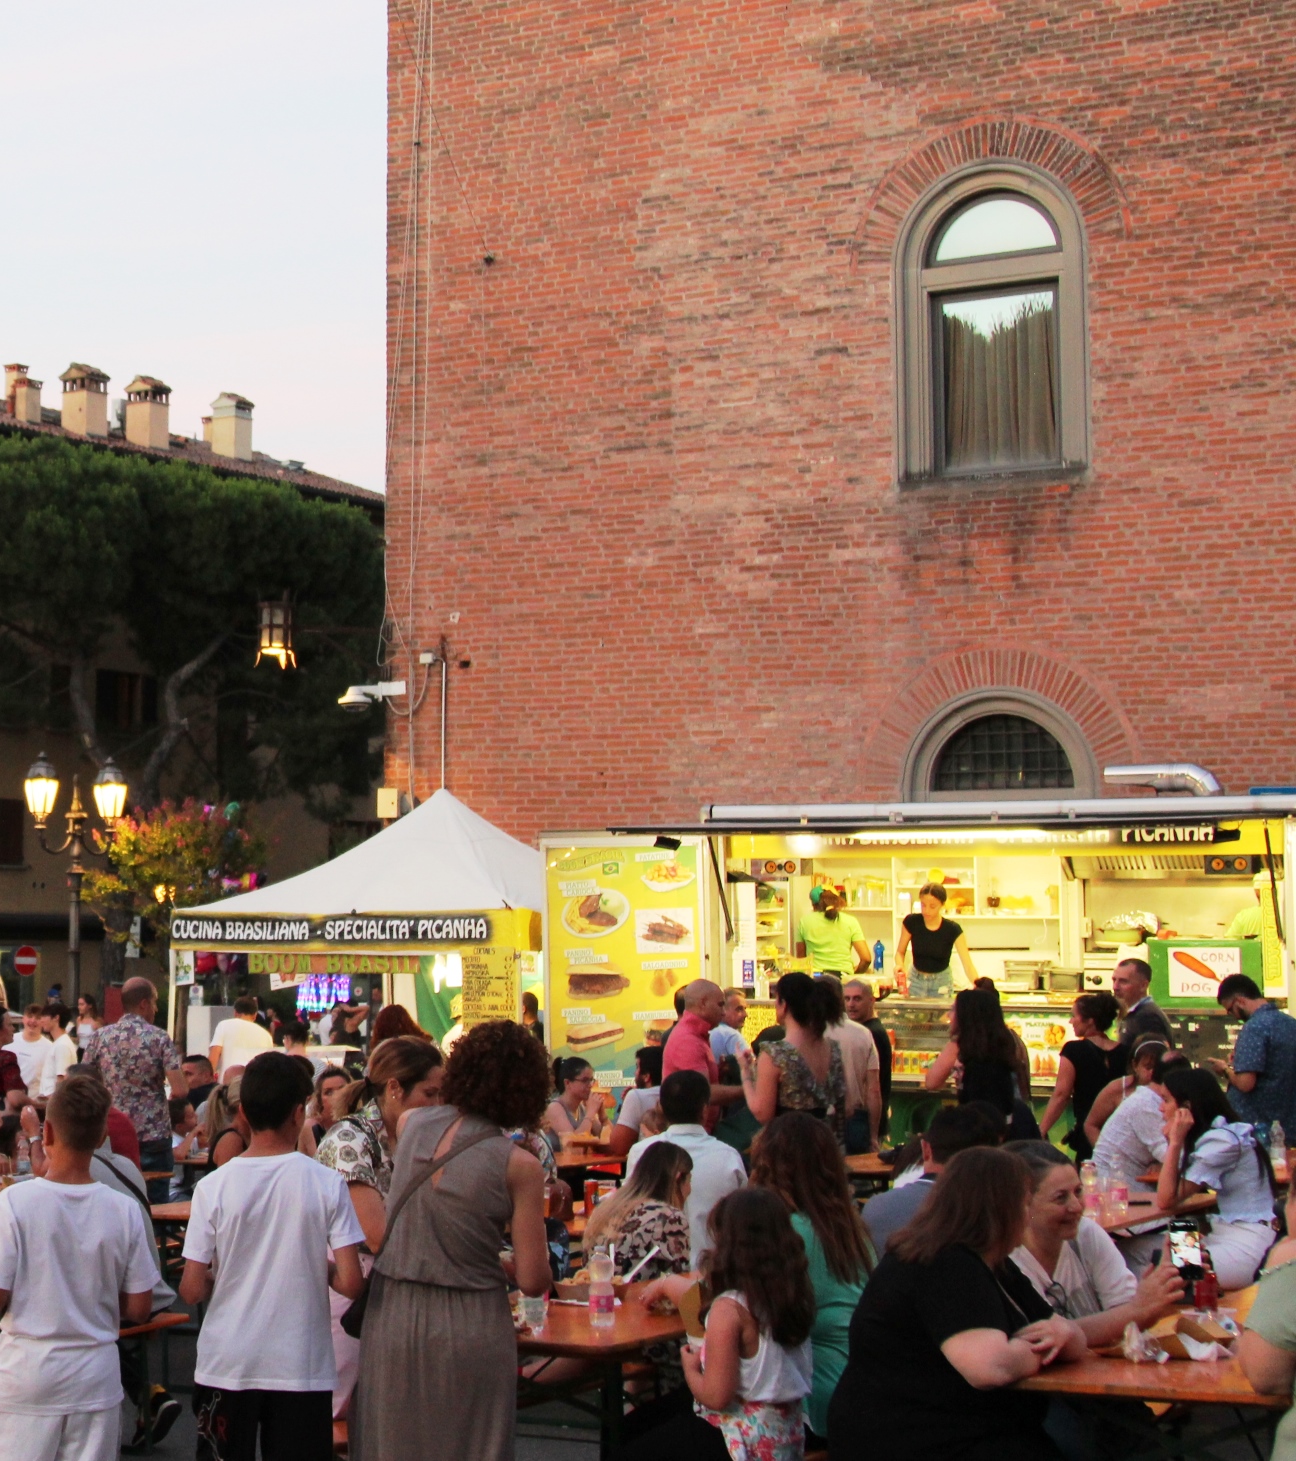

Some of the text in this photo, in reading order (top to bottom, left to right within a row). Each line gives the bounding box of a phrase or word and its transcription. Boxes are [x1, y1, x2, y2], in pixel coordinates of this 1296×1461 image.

[639, 852, 670, 861] PATATINE
[566, 888, 596, 896] CARIOCA
[172, 921, 222, 939] CUCINA
[225, 921, 309, 940] BRASILIANA
[324, 919, 415, 940] SPECIALITA'
[417, 918, 488, 939] PICANHA
[566, 949, 591, 957] PANINO
[1200, 951, 1235, 963] CORN
[248, 953, 420, 974] BOOM BRASIL
[574, 956, 604, 964] PICANHA
[642, 961, 686, 969] SALGADINHO
[1181, 982, 1212, 993] DOG
[564, 1009, 589, 1017] PANINO
[596, 1071, 621, 1079] PANINO
